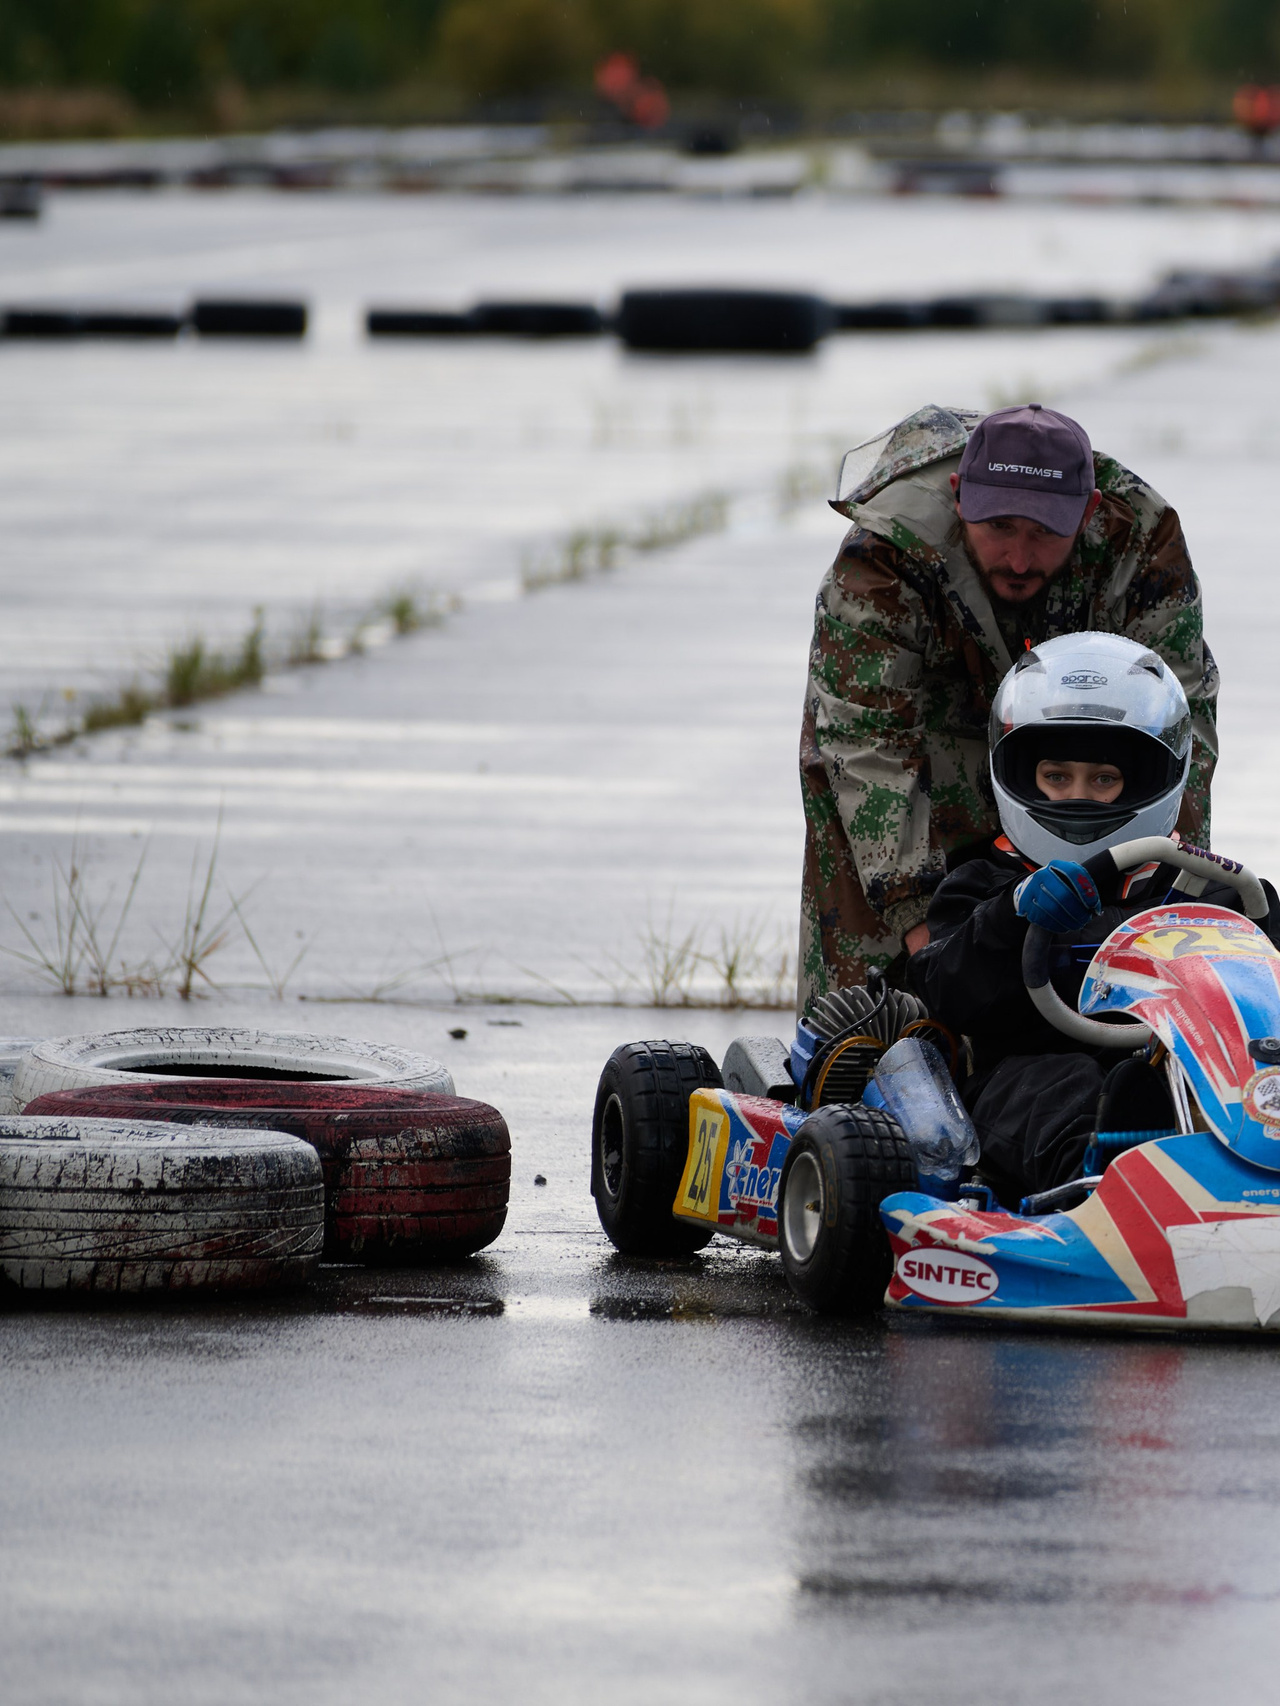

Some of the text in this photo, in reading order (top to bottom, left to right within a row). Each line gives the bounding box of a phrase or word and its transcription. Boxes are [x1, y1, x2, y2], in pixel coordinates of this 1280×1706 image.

[1153, 927, 1277, 958] 25
[688, 1119, 718, 1203] 25
[903, 1260, 992, 1290] SINTEC
